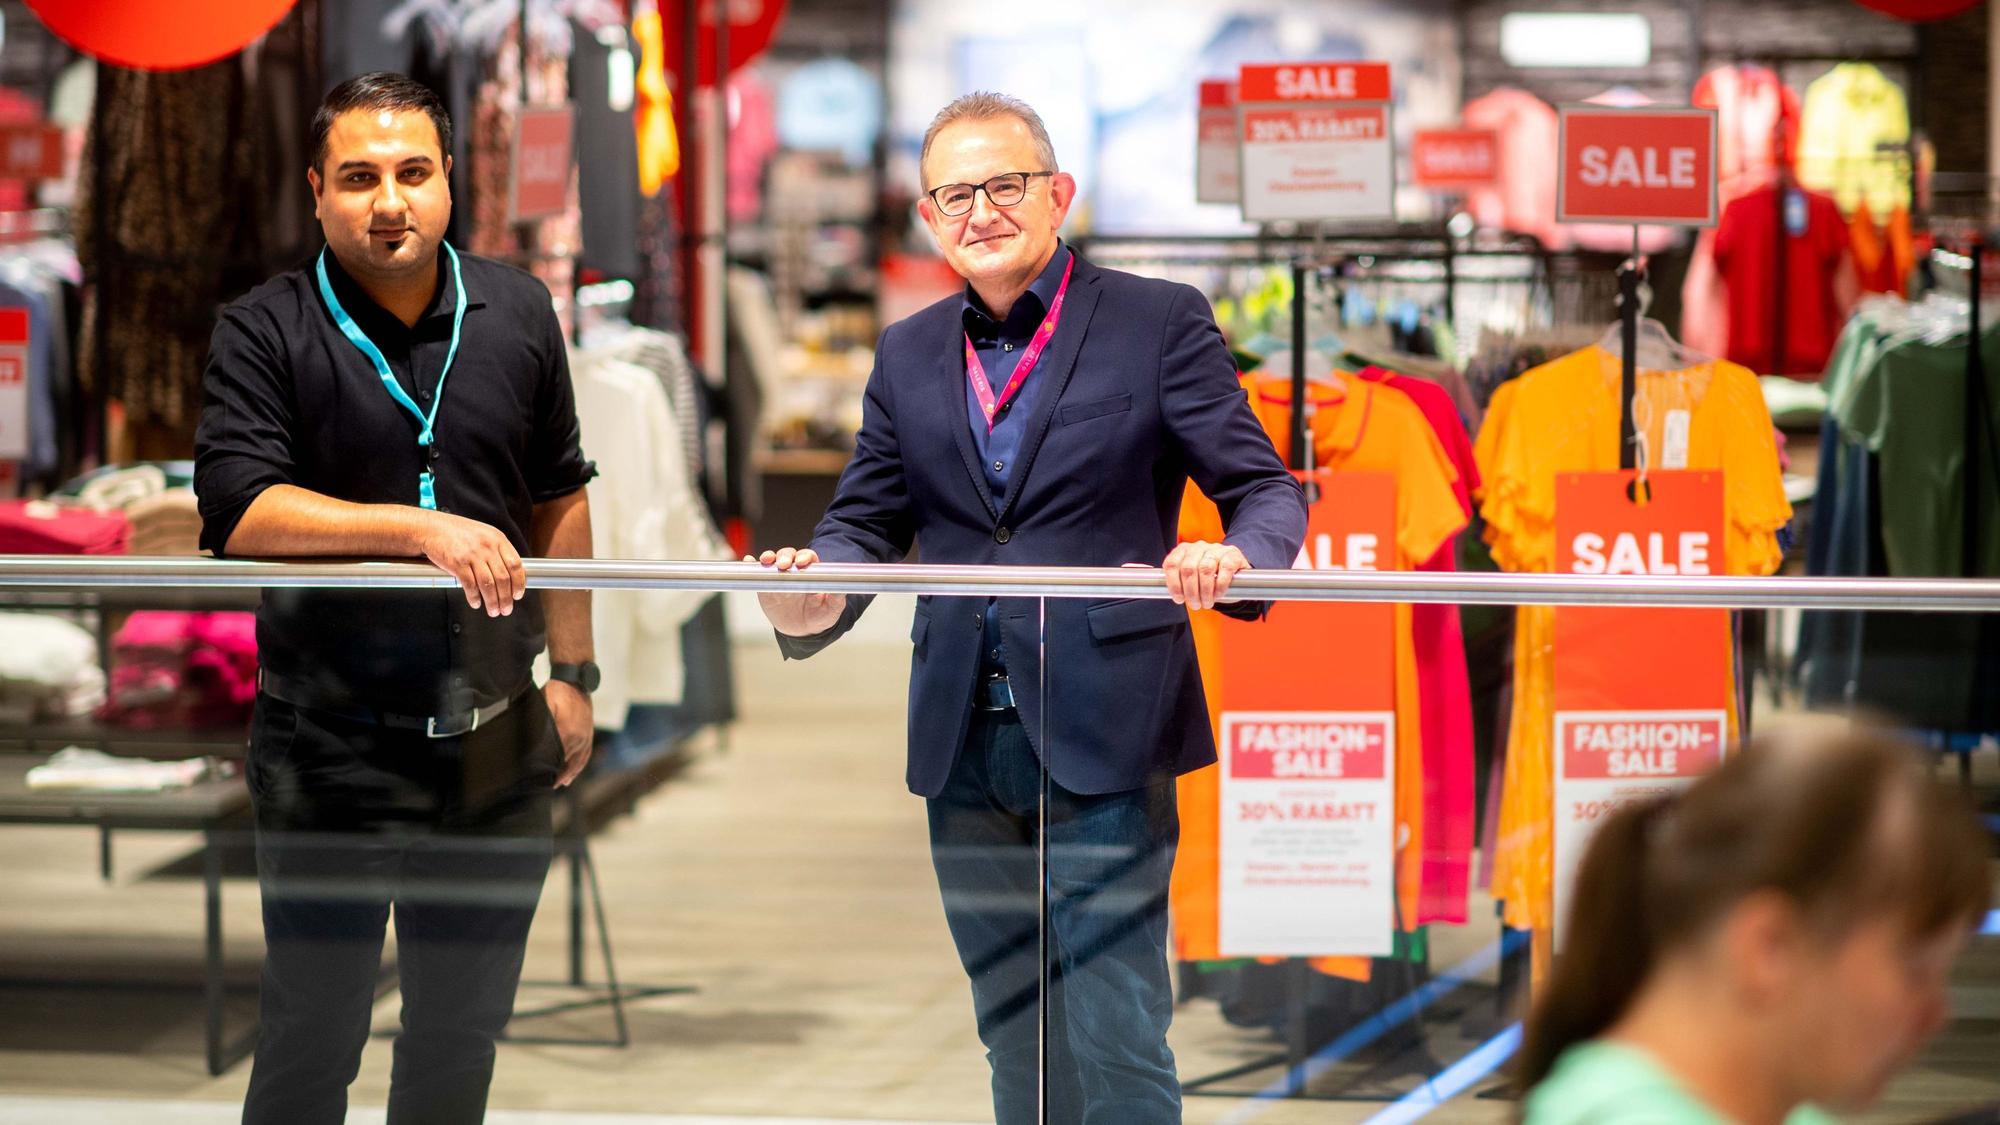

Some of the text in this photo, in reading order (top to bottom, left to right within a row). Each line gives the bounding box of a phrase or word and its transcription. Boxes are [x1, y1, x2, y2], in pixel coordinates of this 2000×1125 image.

[1274, 67, 1357, 97] SALE
[1579, 145, 1696, 188] SALE
[1291, 532, 1378, 571] LE
[1571, 532, 1710, 575] SALE
[1239, 724, 1381, 751] FASHION-
[1574, 723, 1715, 751] FASHION-
[1273, 750, 1344, 777] SALE
[1607, 749, 1678, 776] SALE
[1239, 801, 1377, 821] 30% RABATT
